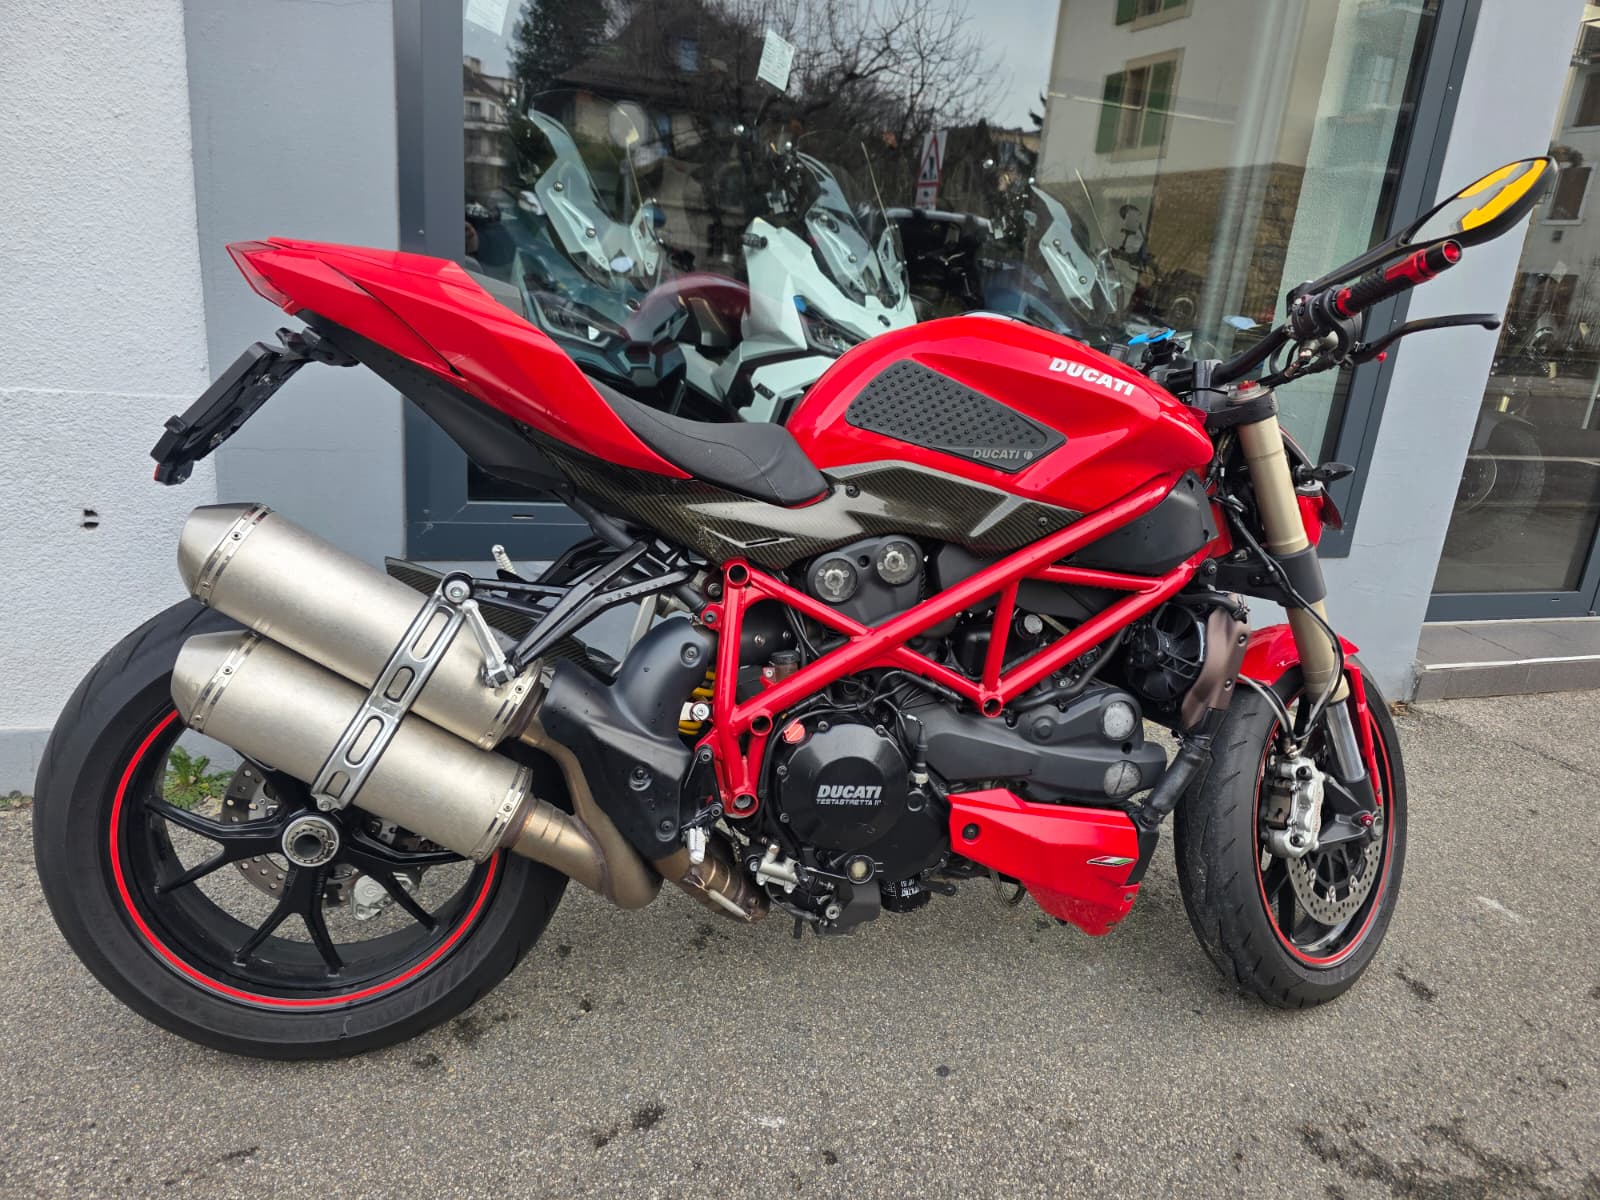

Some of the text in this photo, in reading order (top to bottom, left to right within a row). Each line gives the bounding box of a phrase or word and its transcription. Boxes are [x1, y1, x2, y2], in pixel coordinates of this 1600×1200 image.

[1048, 357, 1136, 397] DUCATI
[973, 449, 1020, 460] DUCATI
[817, 785, 882, 799] DUCATI
